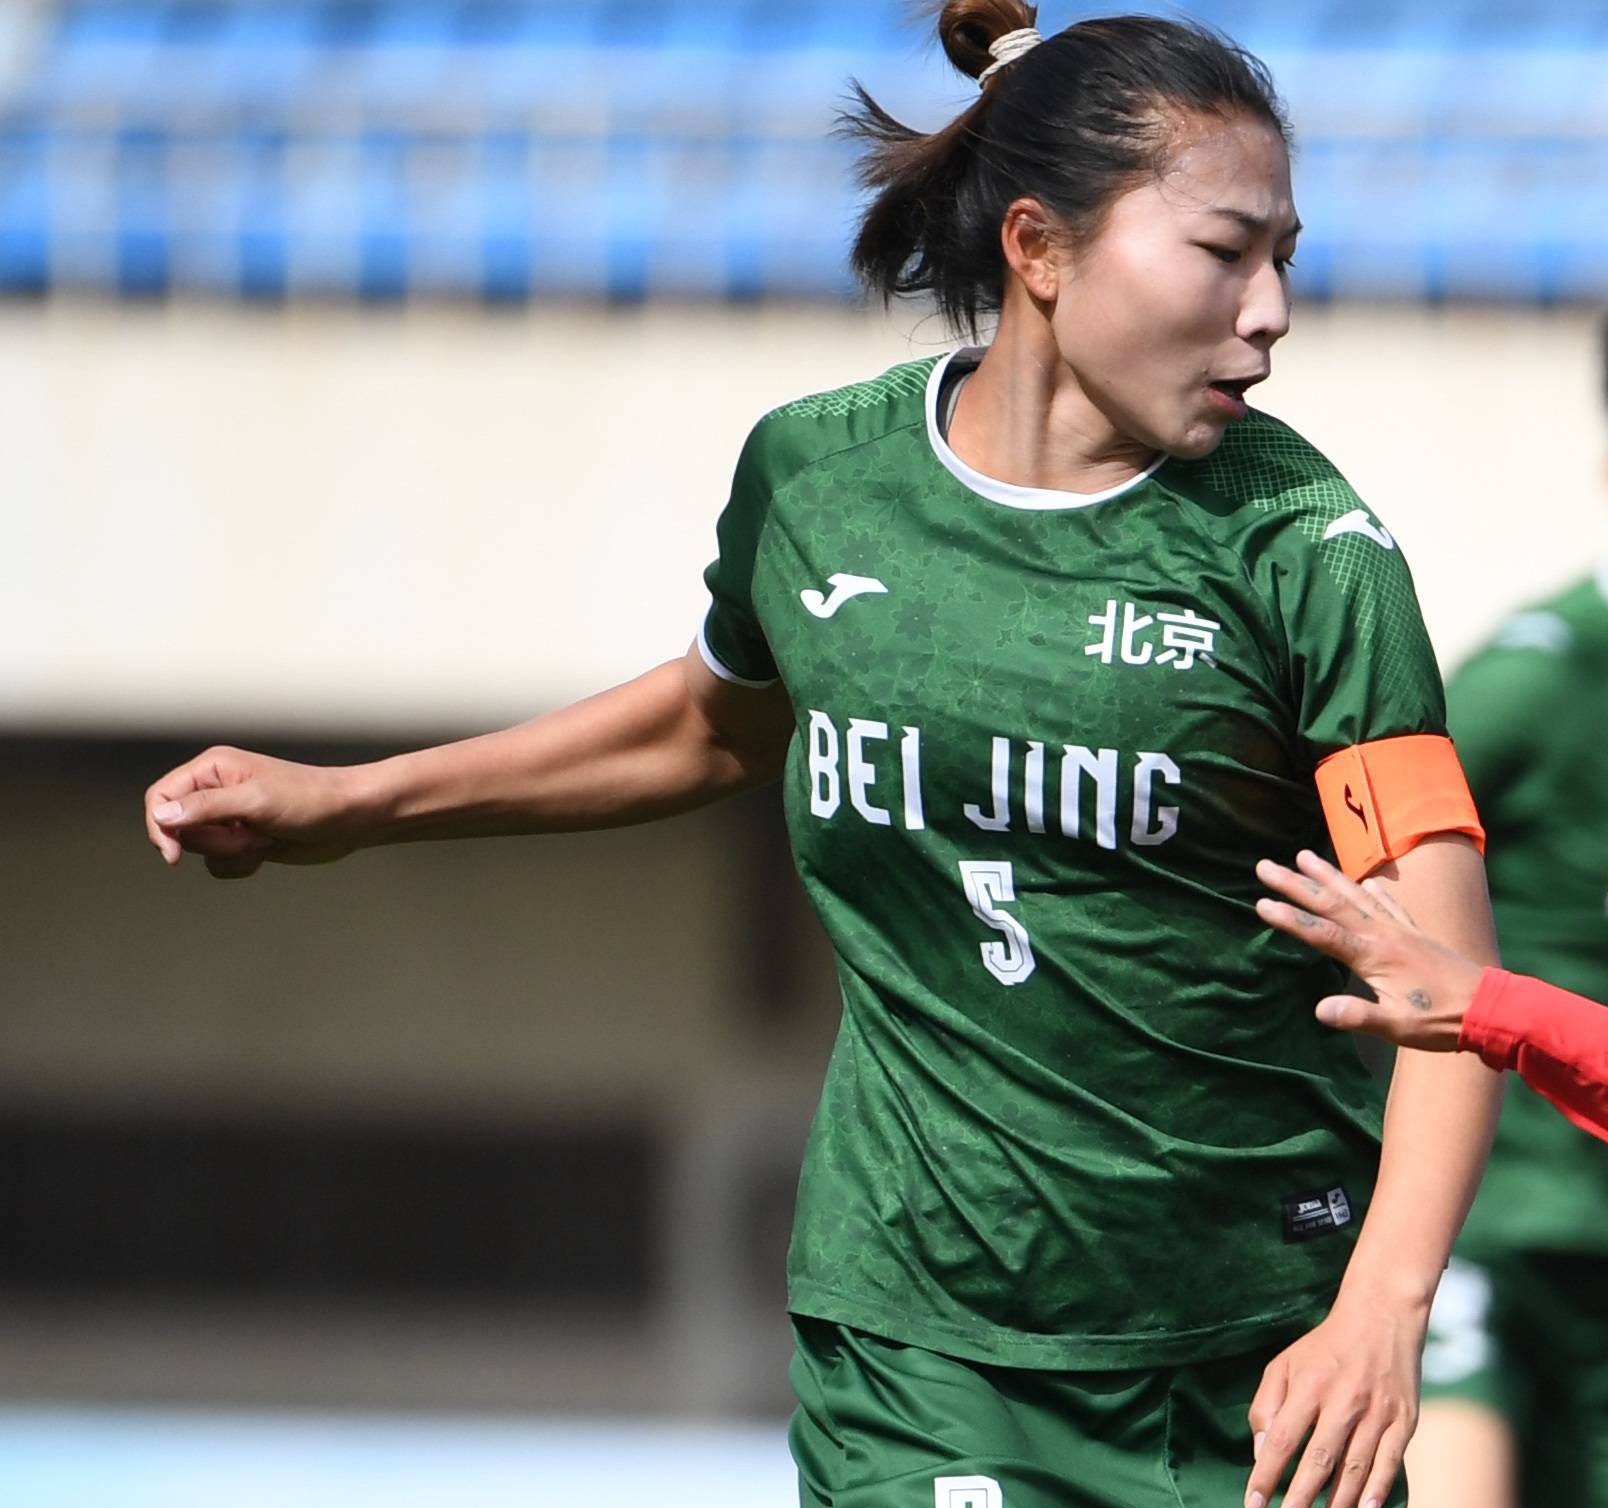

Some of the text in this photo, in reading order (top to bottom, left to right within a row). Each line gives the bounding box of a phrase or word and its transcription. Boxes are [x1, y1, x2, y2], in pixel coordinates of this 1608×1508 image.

[1084, 600, 1220, 670] 北京
[808, 709, 1181, 850] BEI JING
[958, 860, 1037, 986] 5
